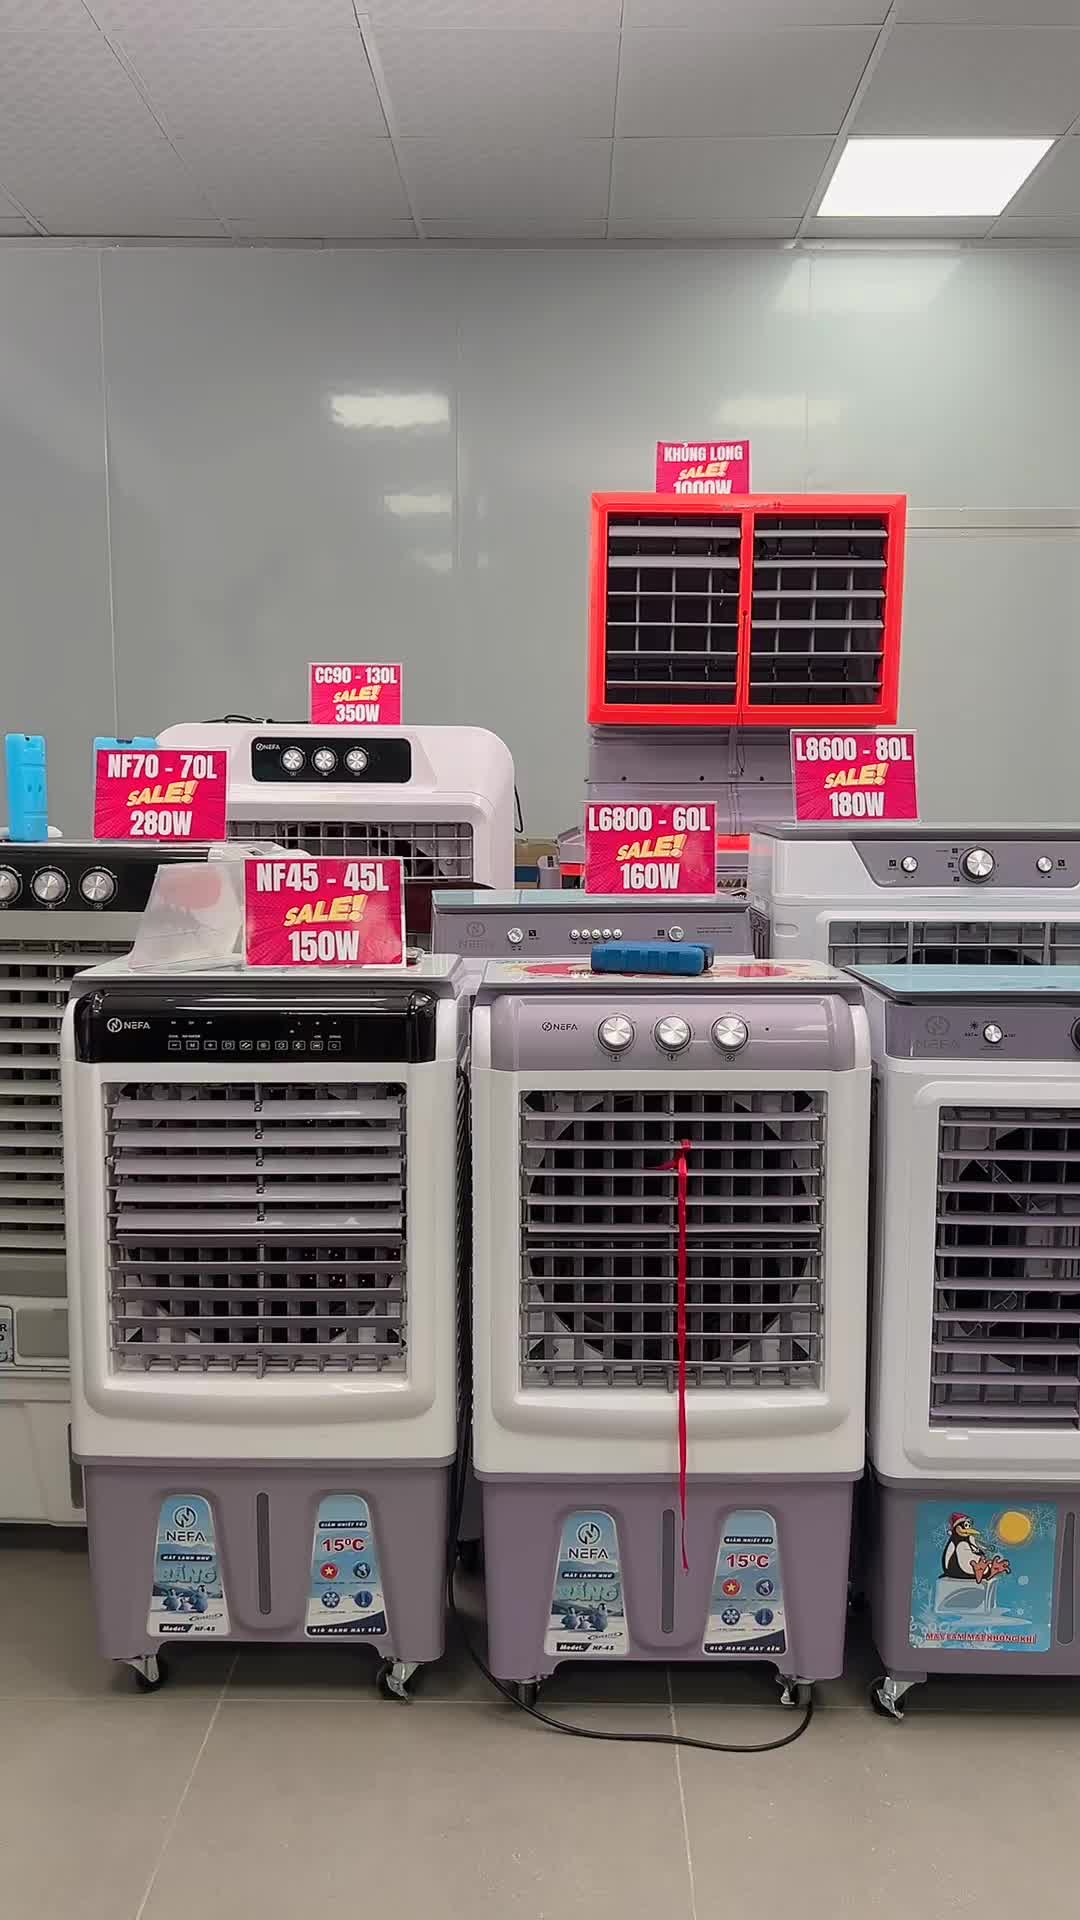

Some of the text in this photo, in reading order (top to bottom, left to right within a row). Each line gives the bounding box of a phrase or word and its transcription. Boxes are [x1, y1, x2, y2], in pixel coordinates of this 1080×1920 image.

[664, 443, 743, 462] KHỦNG LONG
[678, 462, 729, 481] SALE!
[315, 667, 352, 684] CC90
[365, 667, 398, 684] 130L
[333, 685, 382, 704] SALE!
[335, 704, 380, 723] 350W
[796, 737, 857, 761] L8600
[876, 737, 913, 761] 80L
[107, 754, 159, 778] NF70
[180, 755, 217, 779] 70L
[824, 763, 889, 789] SALE!
[126, 780, 199, 807] SALE!
[829, 792, 885, 817] 180W
[130, 810, 192, 836] 280W
[588, 807, 653, 831] L6800
[673, 807, 711, 831] 60L
[616, 833, 688, 861] SALE!
[256, 863, 319, 892] NF45
[343, 863, 389, 892] 45L
[620, 863, 680, 889] 160W
[283, 894, 369, 927] SALE!
[288, 930, 360, 961] 150W
[123, 1021, 151, 1030] NEFA
[553, 1023, 578, 1031] NEFA
[166, 1531, 206, 1541] NEFA
[568, 1547, 609, 1559] NEFA
